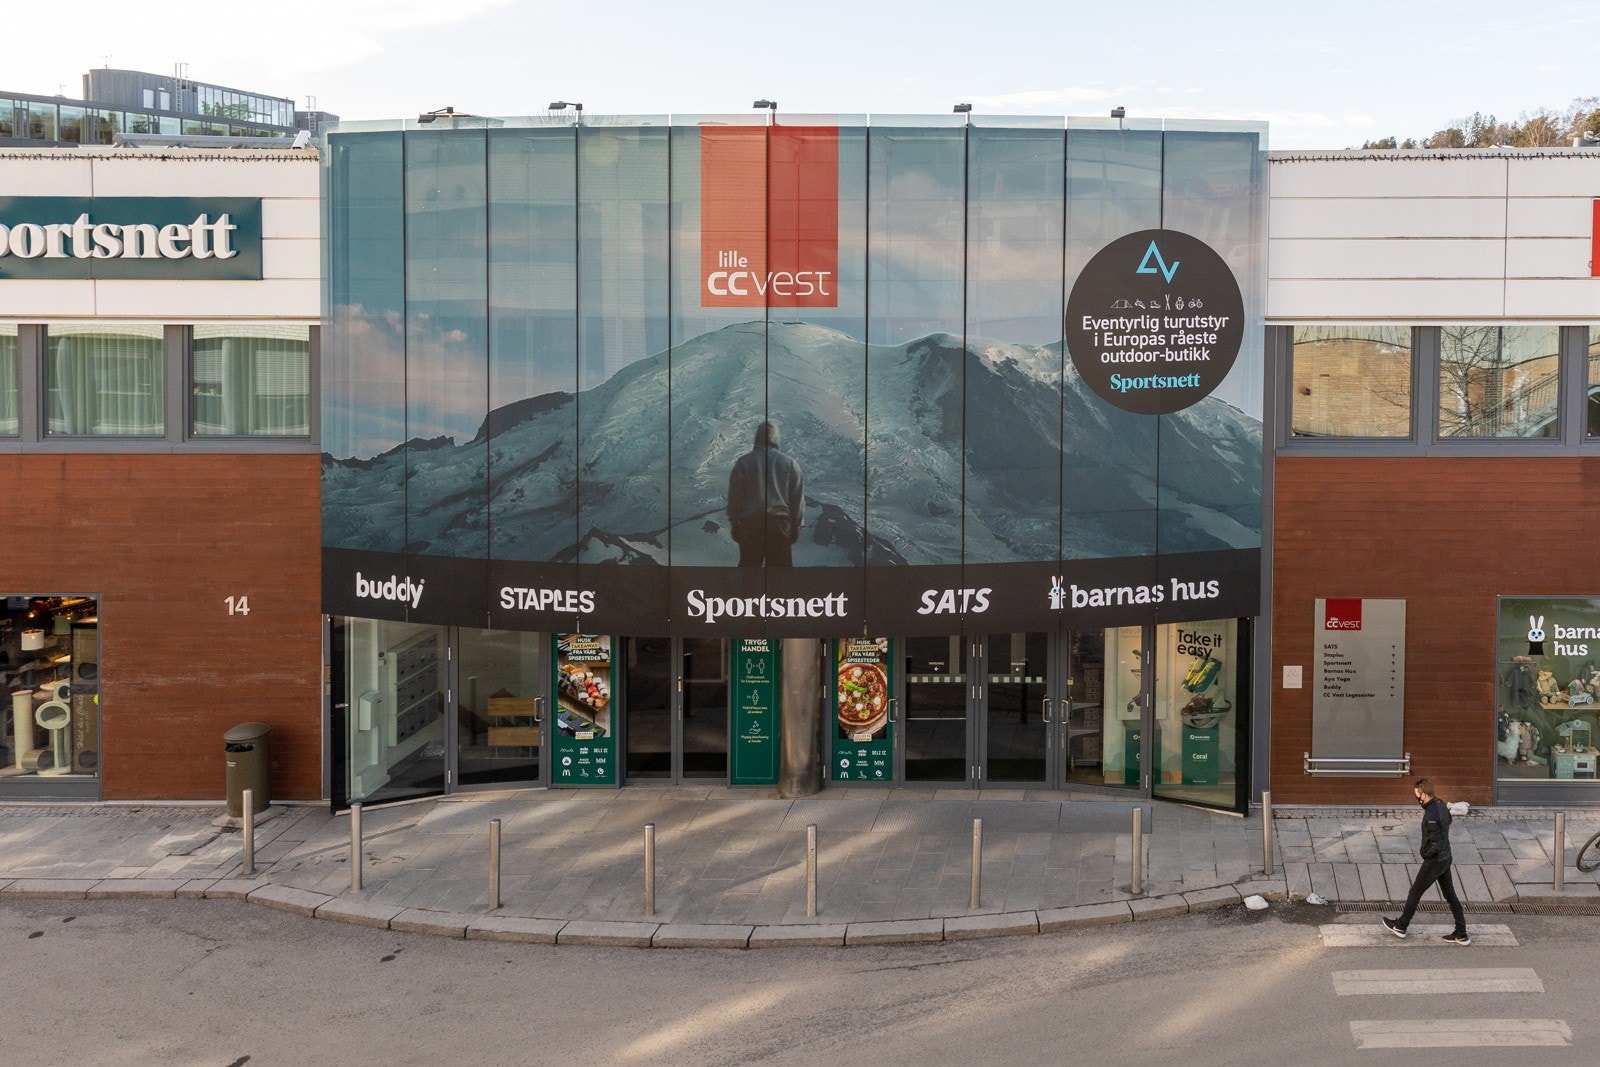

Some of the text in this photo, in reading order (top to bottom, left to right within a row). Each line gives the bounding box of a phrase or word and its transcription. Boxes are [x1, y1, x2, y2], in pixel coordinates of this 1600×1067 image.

[0, 213, 237, 259] ortsnett
[719, 250, 748, 268] lille
[1082, 315, 1229, 332] Eventyrlig turutstyr
[1094, 330, 1217, 349] i Europas råeste
[1101, 347, 1210, 363] outdoor-butikk
[1110, 373, 1201, 393] Sportsnett
[356, 572, 424, 609] buddy
[500, 587, 595, 613] STAPLES
[1070, 578, 1220, 608] barnas hus
[224, 595, 250, 616] 14
[687, 589, 848, 623] Sportsnett
[917, 587, 993, 615] SATS
[1177, 630, 1222, 647] Take it
[1554, 641, 1588, 656] hus
[1177, 644, 1213, 661] easy
